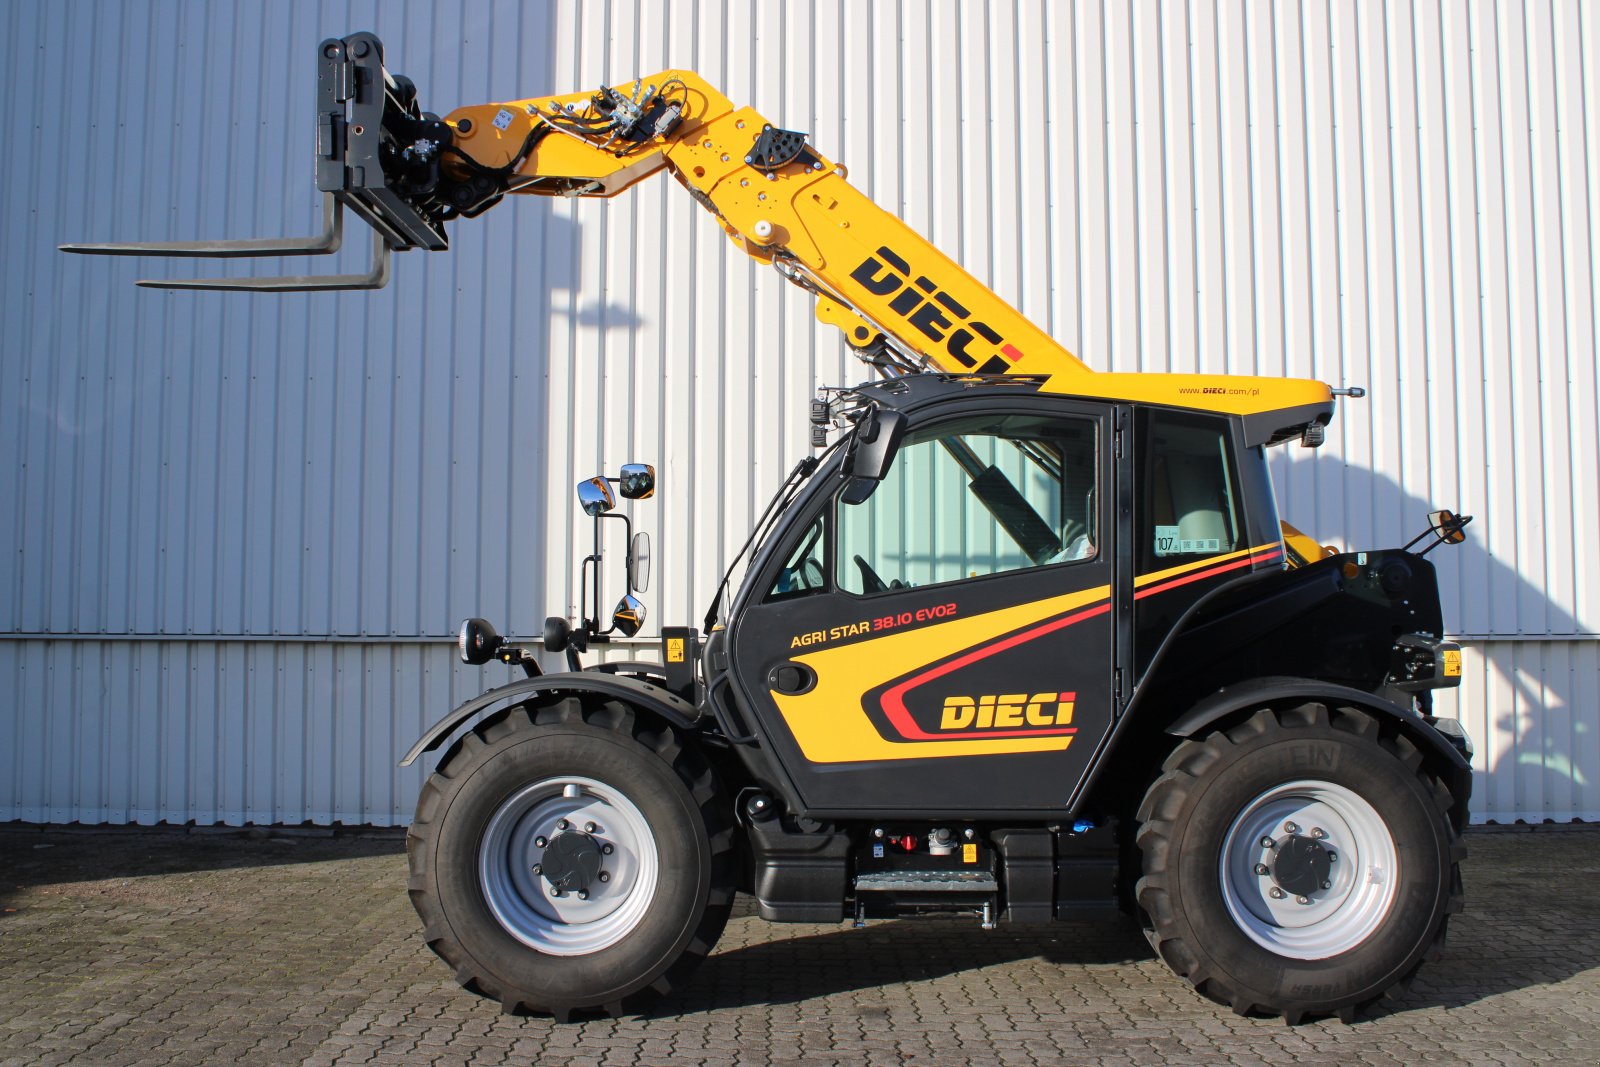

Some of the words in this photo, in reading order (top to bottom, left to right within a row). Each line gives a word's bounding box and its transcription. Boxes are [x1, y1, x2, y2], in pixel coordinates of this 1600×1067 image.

[1157, 537, 1174, 551] 107
[790, 630, 827, 649] AGRI
[830, 621, 870, 640] STAR
[873, 612, 912, 631] 38.10
[915, 603, 957, 621] EVO2
